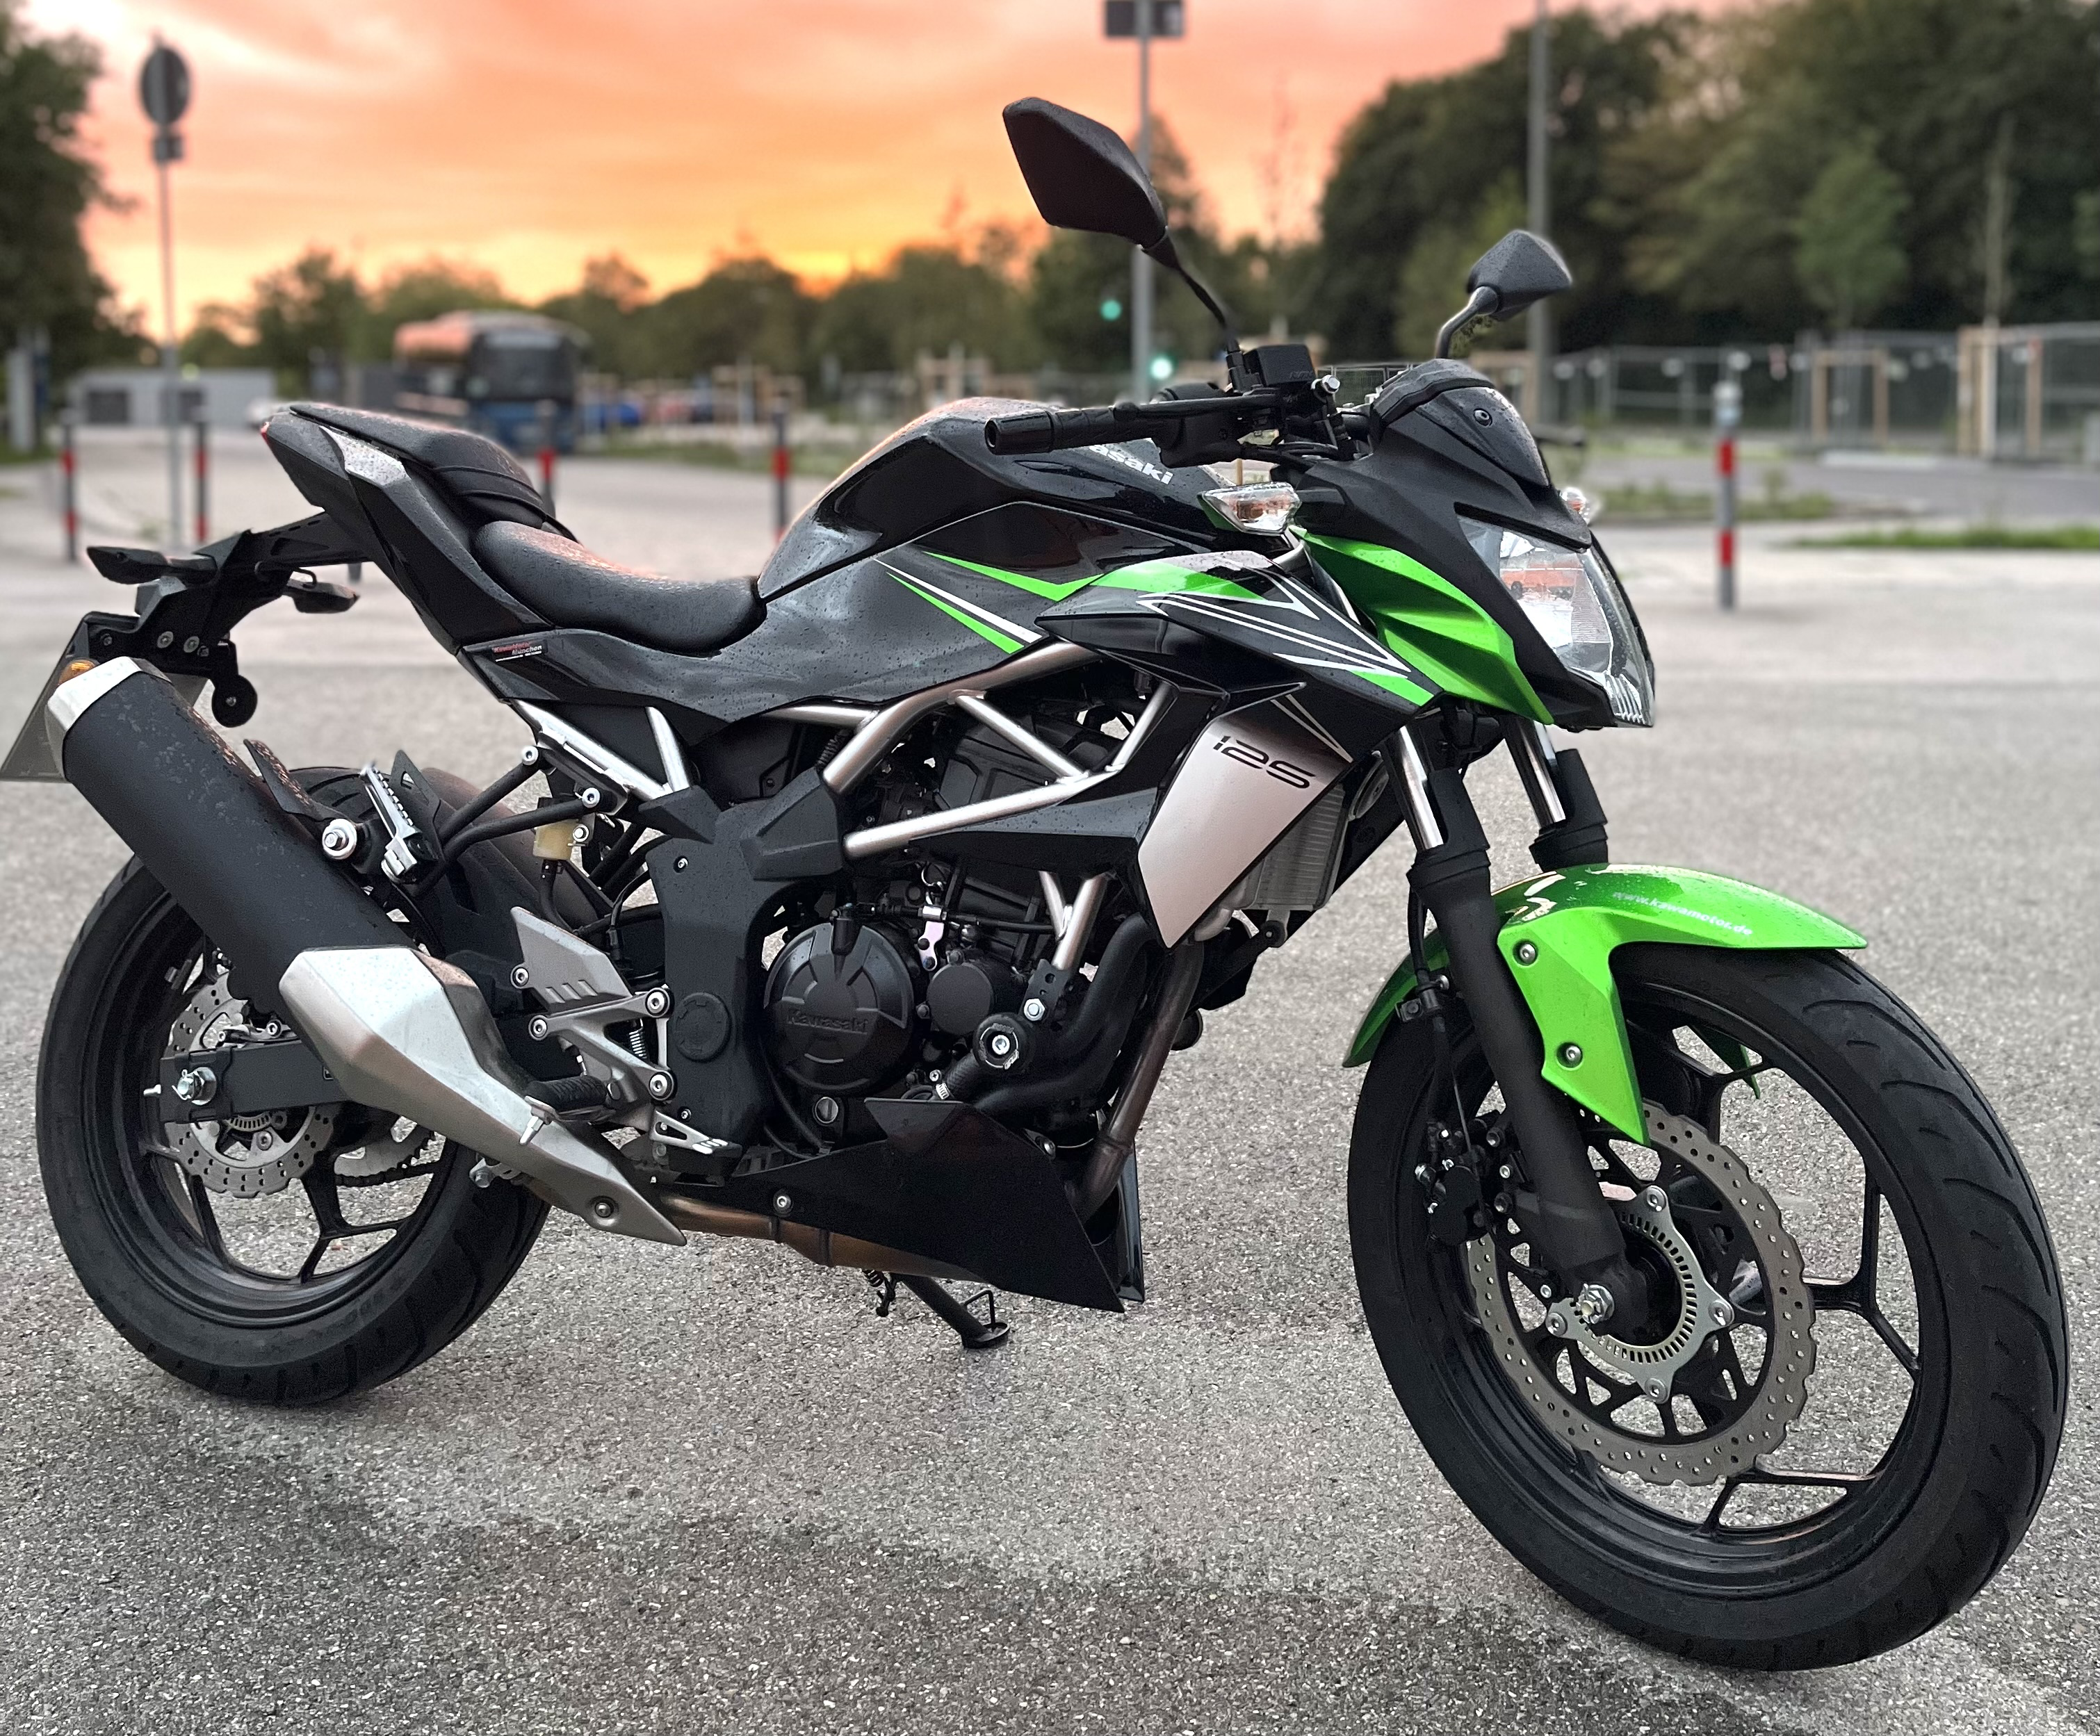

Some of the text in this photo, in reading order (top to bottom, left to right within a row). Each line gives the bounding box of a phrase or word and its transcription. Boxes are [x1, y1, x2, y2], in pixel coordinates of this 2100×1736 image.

[1089, 444, 1173, 485] asaki
[1212, 735, 1317, 789] 125
[786, 1008, 869, 1033] Kawasaki
